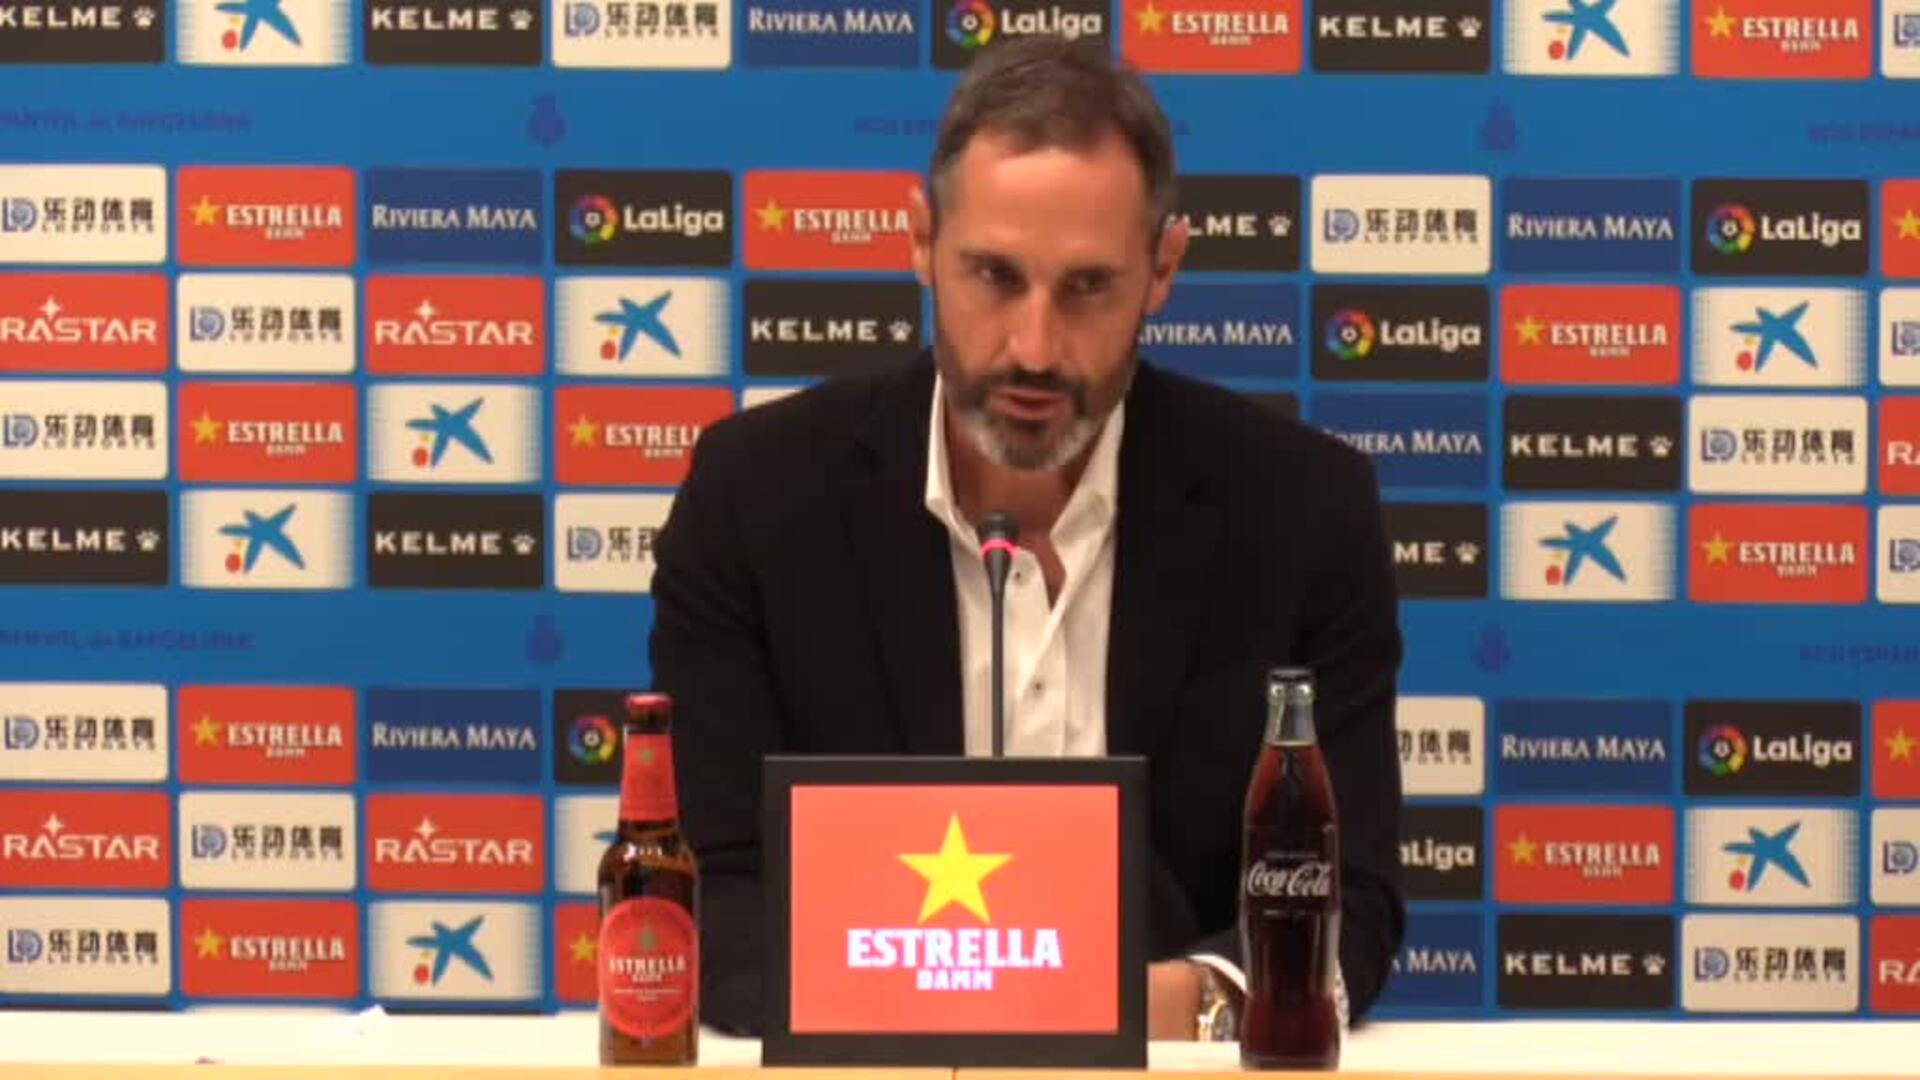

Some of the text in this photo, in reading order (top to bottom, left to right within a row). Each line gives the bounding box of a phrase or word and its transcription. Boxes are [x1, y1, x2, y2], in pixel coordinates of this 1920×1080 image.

[0, 7, 120, 27] KELME
[372, 9, 496, 29] KELME
[749, 8, 912, 32] RIVIERA MAYA
[1002, 8, 1101, 38] LaLiga
[1172, 13, 1289, 35] ESTRELLA
[1320, 17, 1445, 37] KELME
[1743, 18, 1859, 40] ESTRELLA
[227, 208, 342, 230] ESTRELLA
[373, 205, 535, 228] RIVIERA MAYA
[624, 205, 723, 236] LaLiga
[794, 210, 909, 232] ESTRELLA
[1183, 216, 1255, 237] LME
[1509, 214, 1672, 238] RIVIERA MAYA
[1762, 213, 1860, 246] LaLiga
[0, 317, 157, 342] RASTAR
[375, 320, 533, 345] RASTAR
[752, 320, 876, 341] KELME
[1224, 322, 1292, 344] MAYA
[1381, 319, 1480, 351] LaLiga
[1551, 324, 1667, 346] ESTRELLA
[228, 422, 343, 444] ESTRELLA
[606, 425, 700, 446] ESTREL
[1413, 431, 1481, 452] MAYA
[1511, 435, 1636, 456] KELME
[2, 529, 124, 550] KELME
[376, 532, 499, 554] KELME
[1739, 541, 1855, 563] ESTRELLA
[228, 725, 342, 747] ESTRELLA
[373, 723, 535, 747] RIVIERA MAYA
[1502, 735, 1665, 758] RIVIERA MAYA
[1754, 735, 1852, 766] LaLiga
[4, 834, 159, 860] RASTAR
[376, 838, 533, 863] RASTAR
[1400, 839, 1474, 870] Liga
[1545, 843, 1660, 865] ESTRELLA
[231, 936, 345, 958] ESTRELLA
[847, 928, 1062, 968] ESTRELLA
[1408, 949, 1475, 971] MAYA
[1506, 954, 1630, 974] KELME
[917, 967, 994, 990] DAMM
